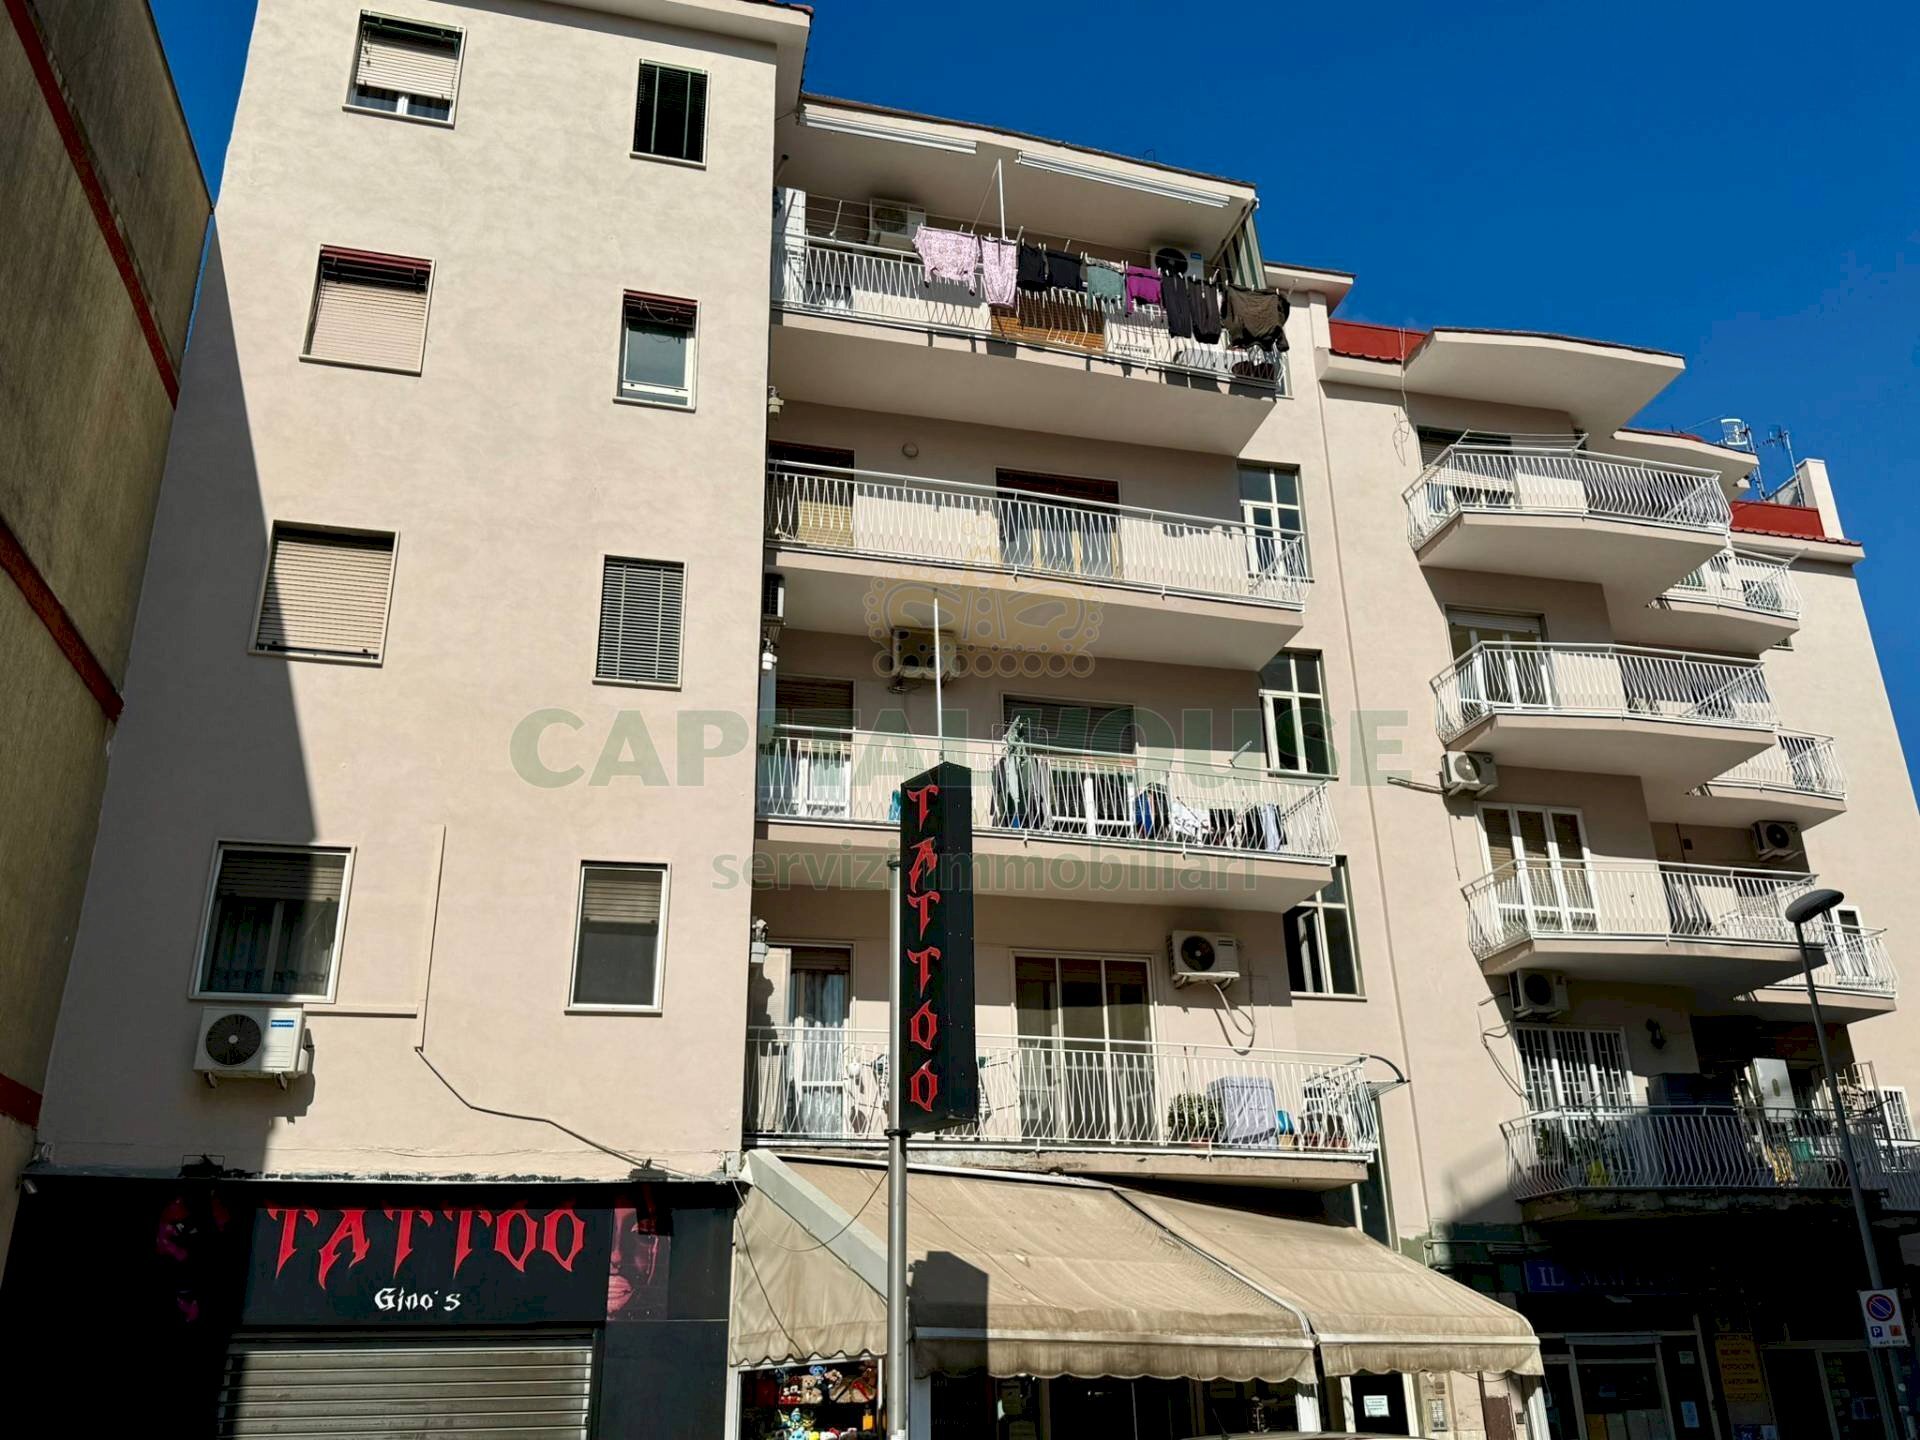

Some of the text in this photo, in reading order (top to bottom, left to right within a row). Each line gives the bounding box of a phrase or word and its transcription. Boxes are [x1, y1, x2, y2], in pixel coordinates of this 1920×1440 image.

[907, 784, 940, 1112] TATTOO
[267, 1200, 585, 1290] TATTOO
[374, 1287, 461, 1312] Gino's
